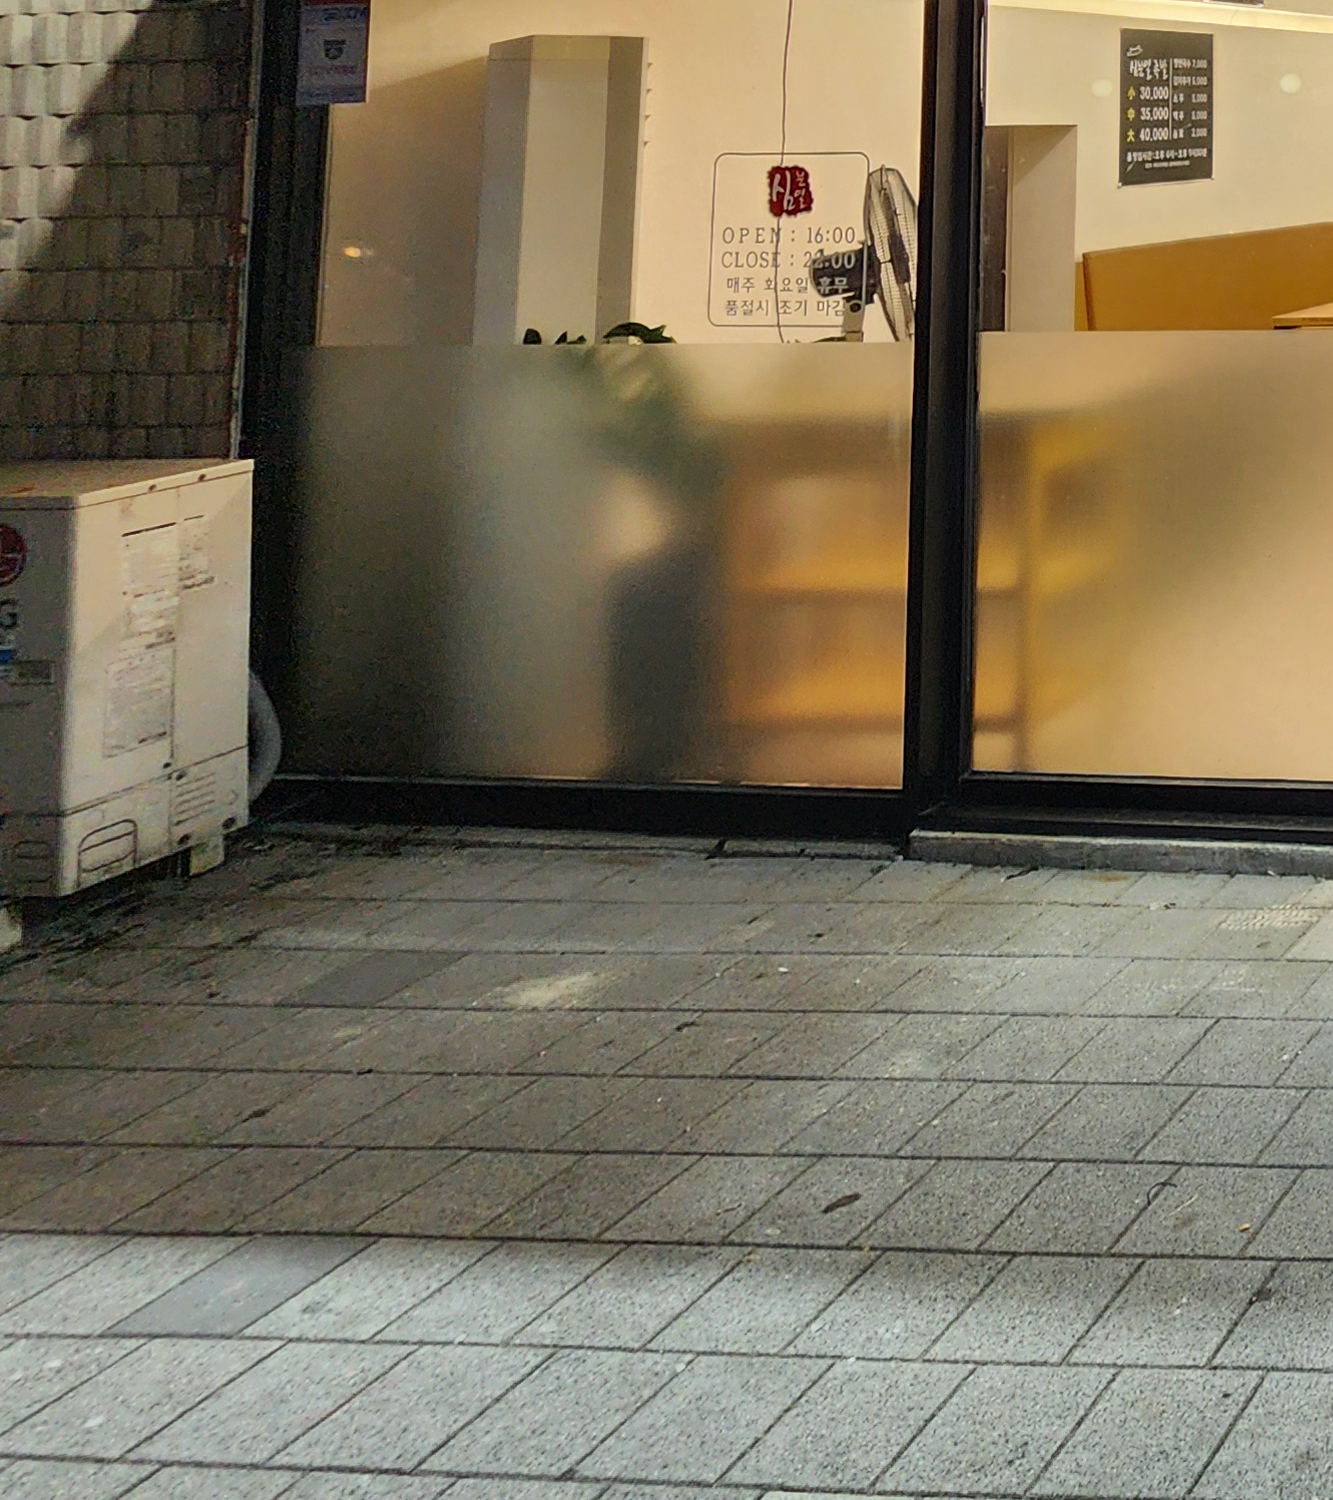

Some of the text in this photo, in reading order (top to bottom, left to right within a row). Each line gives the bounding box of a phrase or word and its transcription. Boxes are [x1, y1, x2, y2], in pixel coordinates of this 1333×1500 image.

[722, 226, 782, 244] OPEN
[806, 226, 856, 244] 16:00
[721, 251, 782, 269] CLOSE
[803, 251, 856, 269] 22:00
[726, 276, 849, 294] 매주 화요일 휴무
[778, 300, 808, 317] 조기
